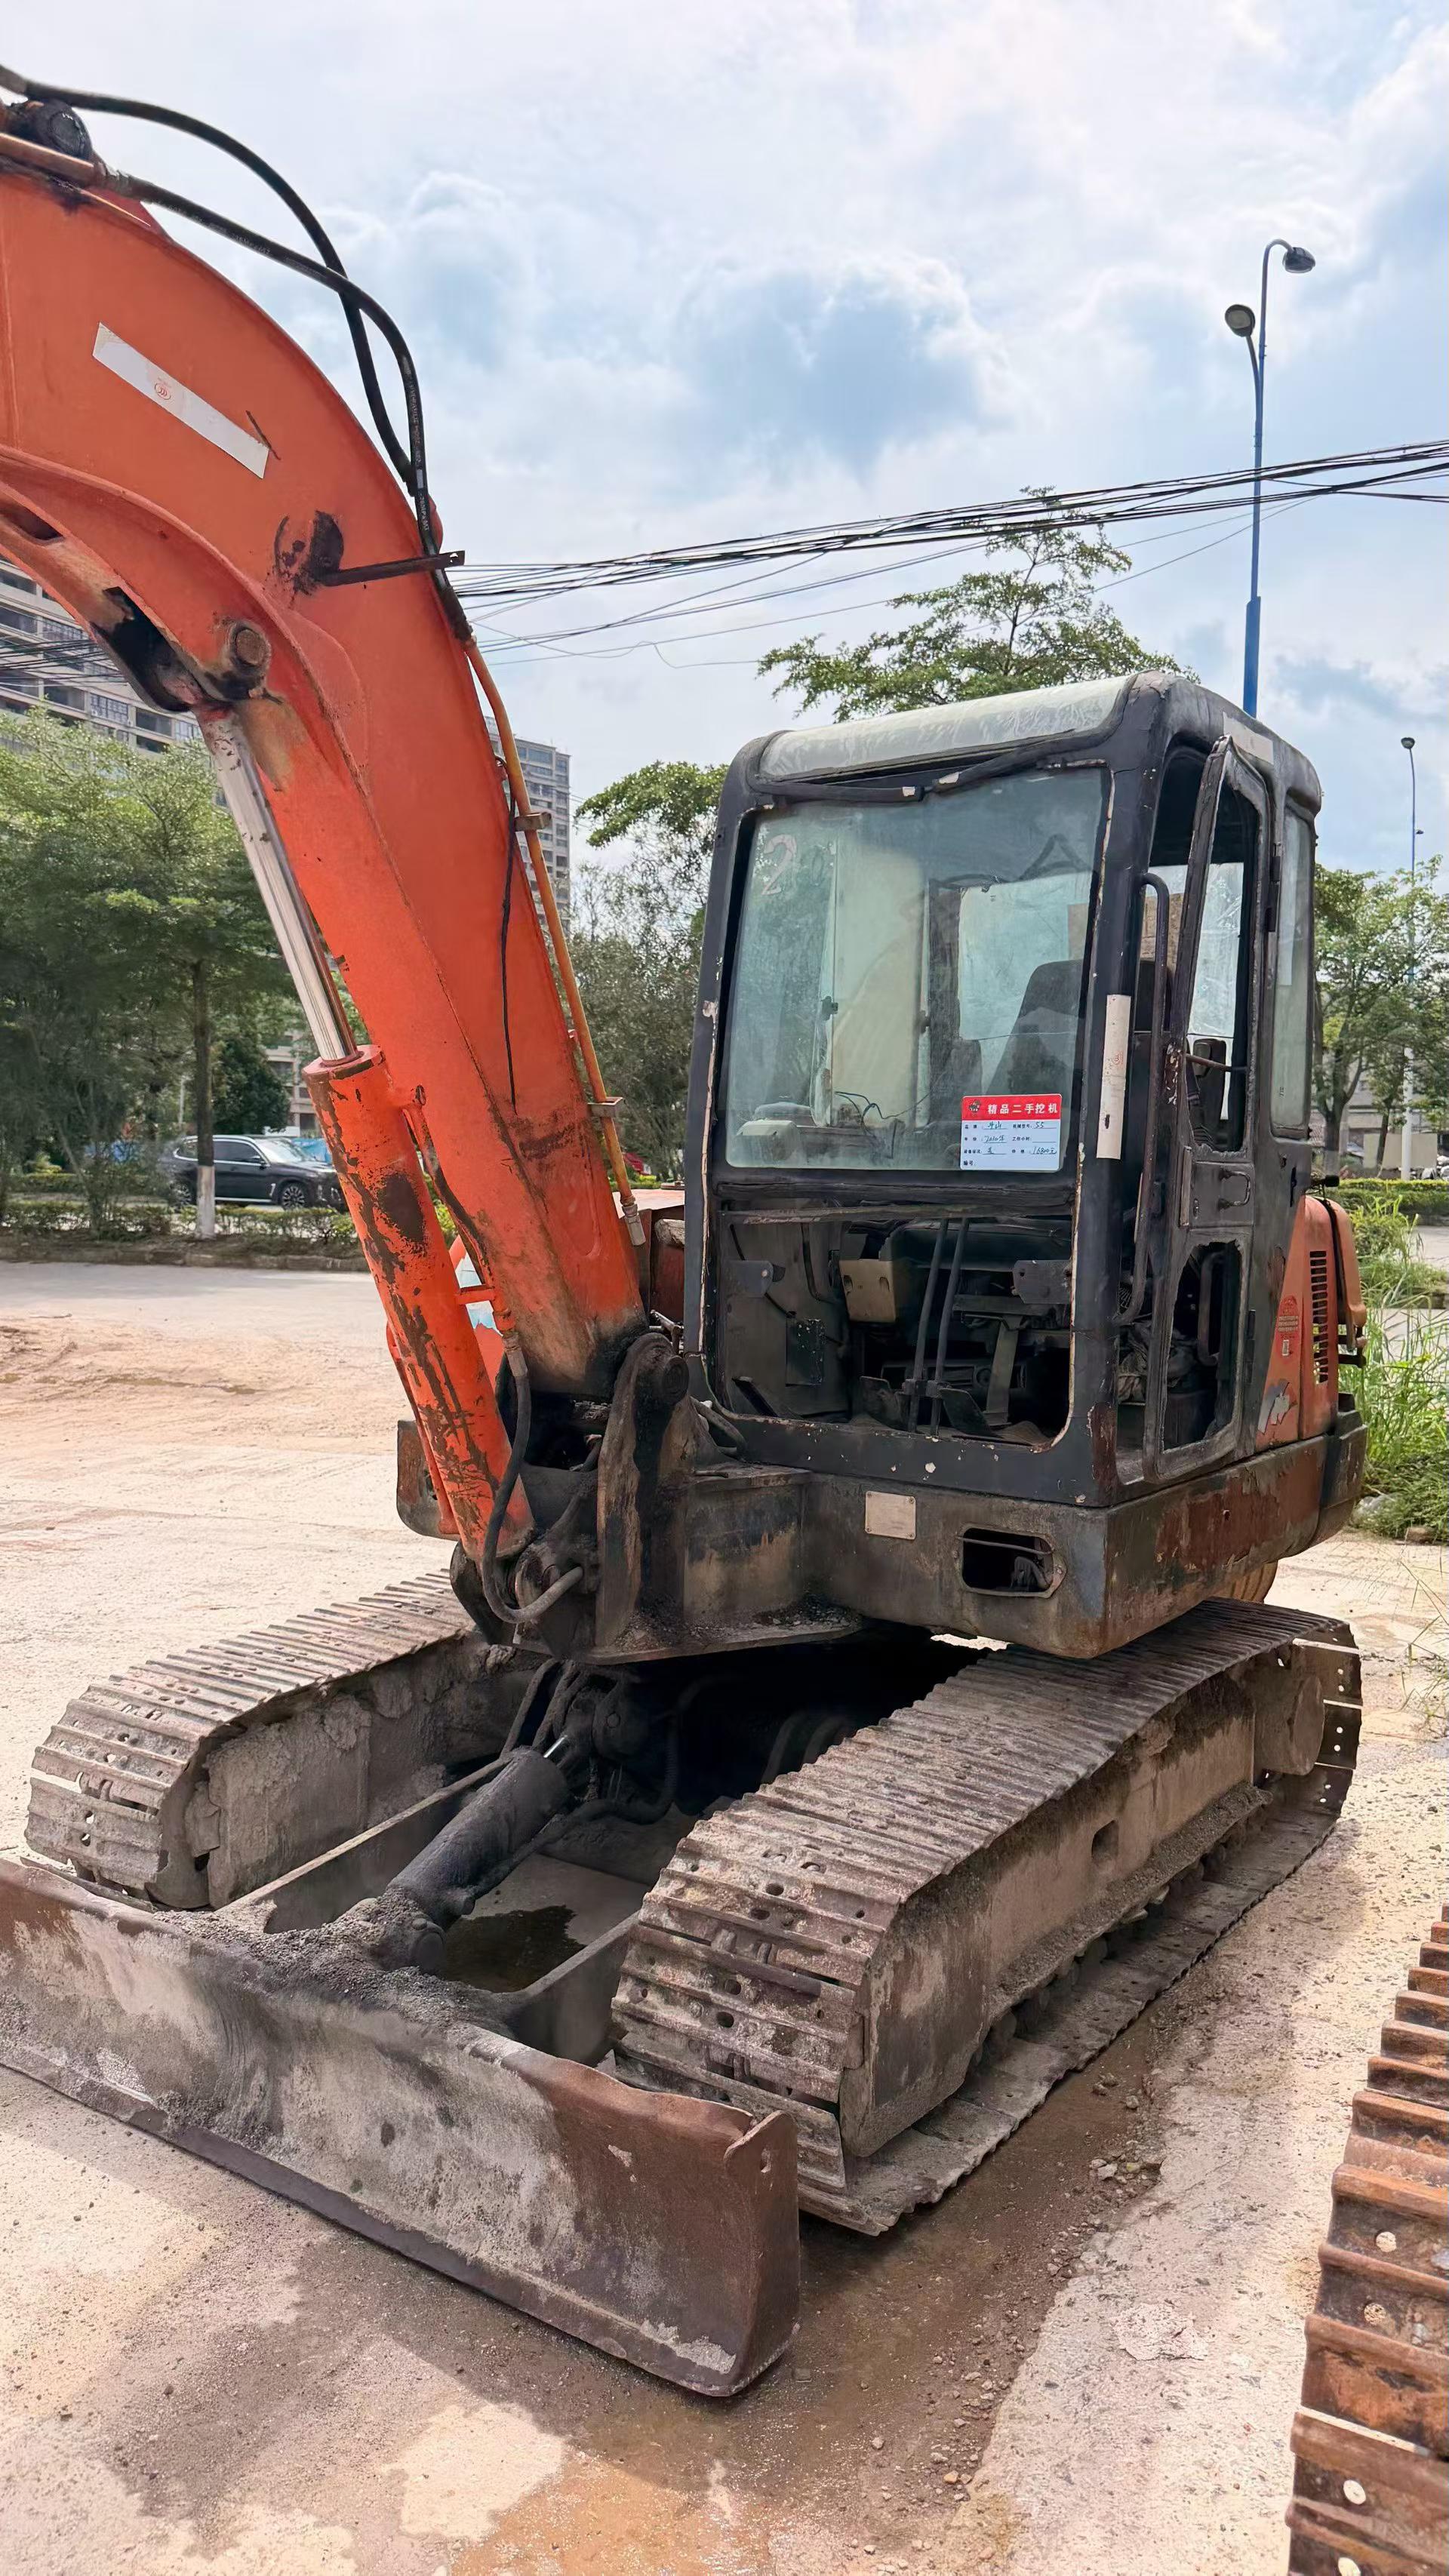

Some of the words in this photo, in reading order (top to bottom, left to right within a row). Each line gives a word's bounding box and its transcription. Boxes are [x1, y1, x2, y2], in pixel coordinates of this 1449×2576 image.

[987, 1103, 1058, 1114] 精品二手挖机
